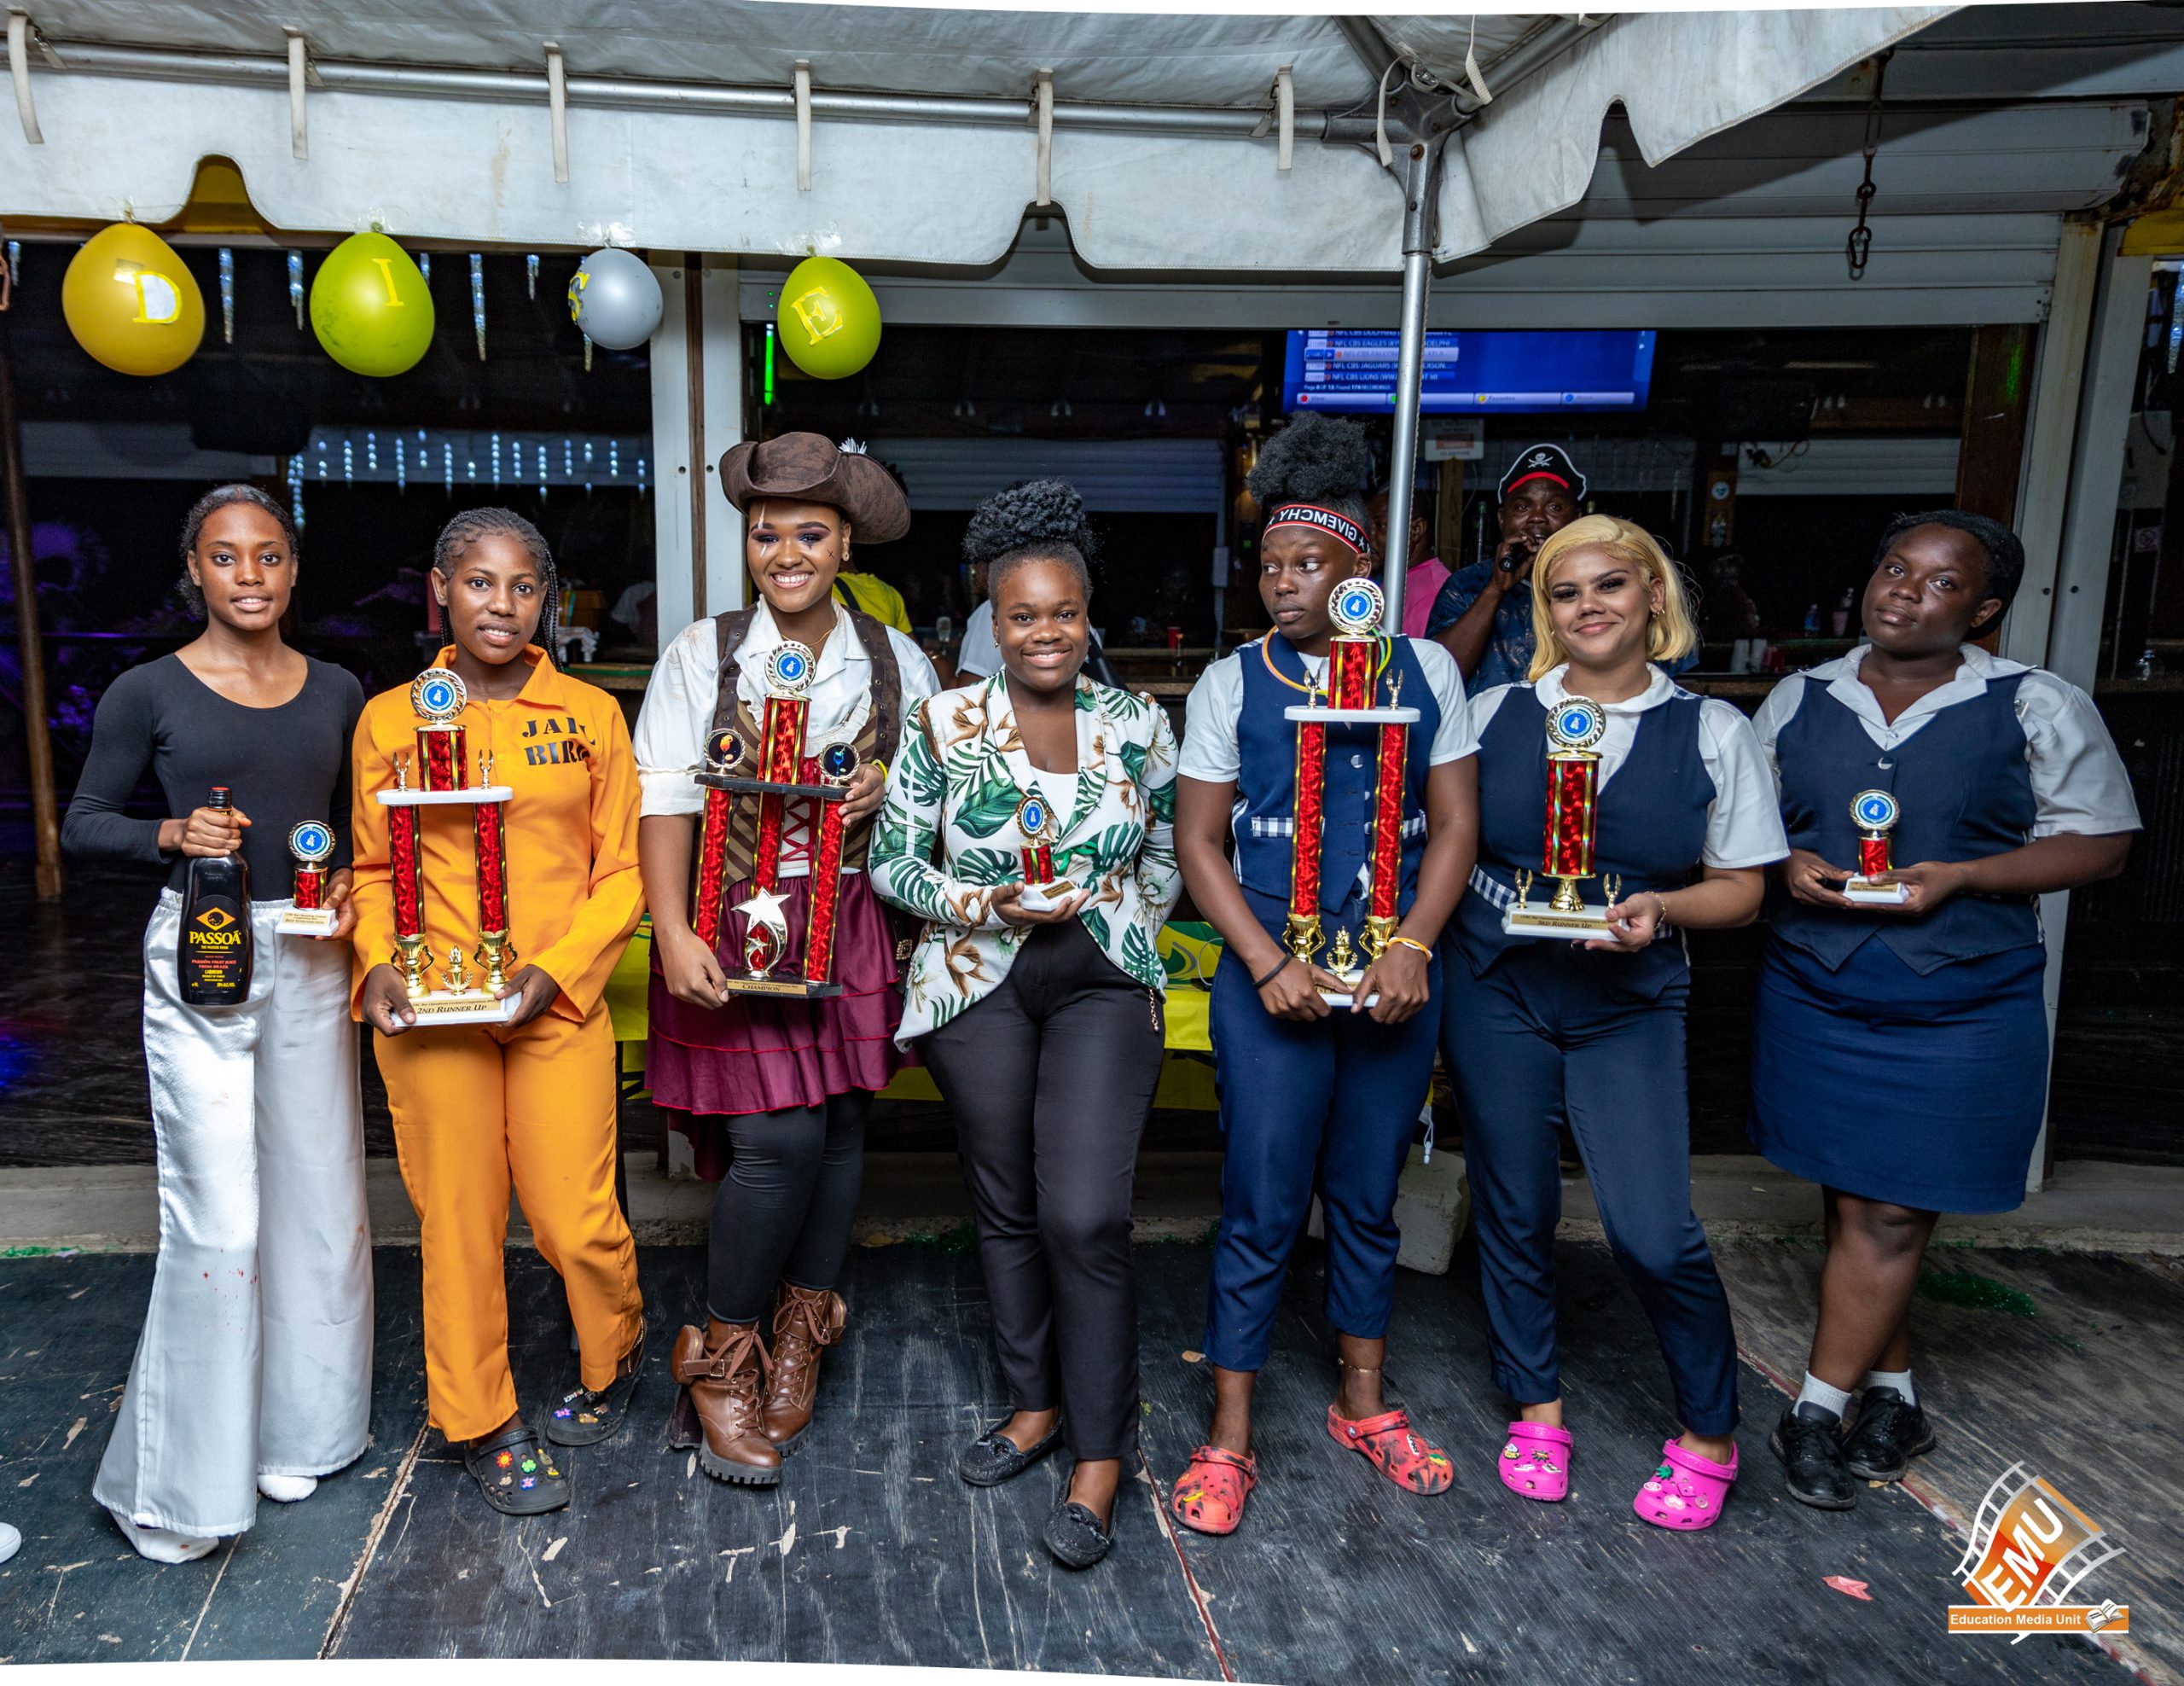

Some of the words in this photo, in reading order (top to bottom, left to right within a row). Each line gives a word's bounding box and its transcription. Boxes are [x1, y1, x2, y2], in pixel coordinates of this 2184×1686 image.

[132, 270, 183, 324] D
[372, 258, 404, 307] I
[790, 286, 845, 346] E
[437, 1005, 472, 1014] RUNNER
